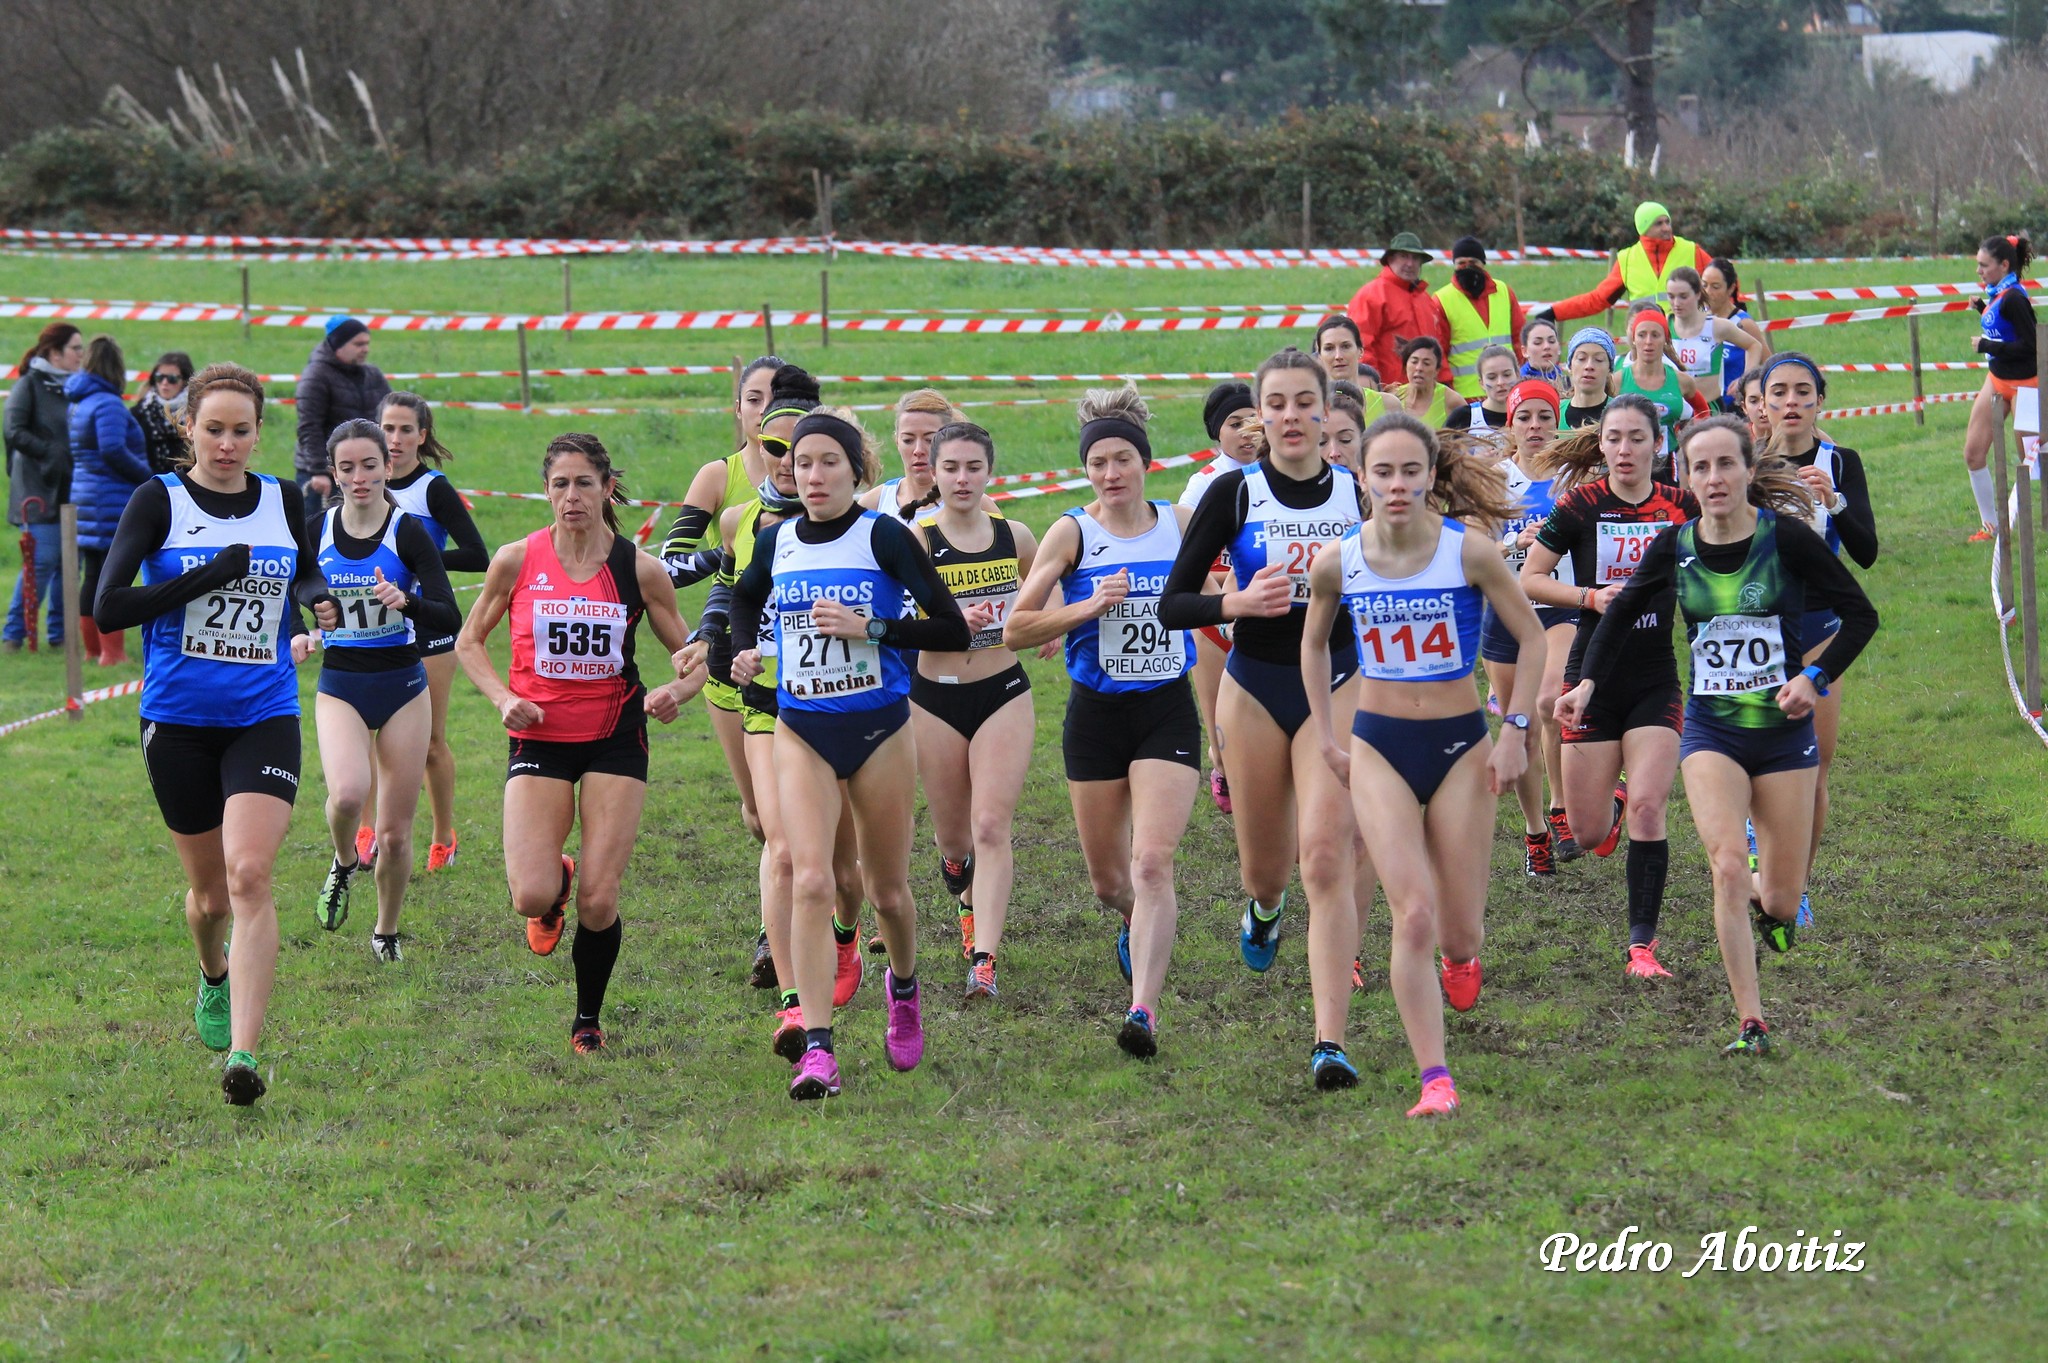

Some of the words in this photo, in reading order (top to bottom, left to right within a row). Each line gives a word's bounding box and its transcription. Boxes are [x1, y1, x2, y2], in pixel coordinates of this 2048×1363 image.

[1681, 349, 1696, 364] 63
[1602, 525, 1650, 535] SELAYA
[330, 574, 384, 585] Piélago
[967, 569, 979, 584] DE
[205, 596, 265, 633] 273
[541, 603, 568, 615] RIO
[573, 604, 620, 618] MIERA
[1372, 614, 1410, 624] E.D.M.
[1413, 610, 1448, 622] Cayón
[198, 629, 219, 638] CENTRO
[353, 630, 380, 639] Talleres
[548, 622, 611, 657] 535
[1122, 622, 1171, 654] 294
[185, 635, 207, 655] La
[213, 639, 274, 660] Encina
[799, 633, 851, 668] 271
[1363, 622, 1455, 663] 114
[1703, 638, 1770, 668] 370
[541, 661, 566, 674] RIO
[571, 662, 615, 675] MIERA
[1106, 656, 1182, 673] PIELAGOS
[1429, 662, 1454, 671] Benito
[785, 680, 807, 696] La
[811, 674, 876, 694] Encina
[1703, 678, 1721, 691] La
[1725, 674, 1778, 690] Encina
